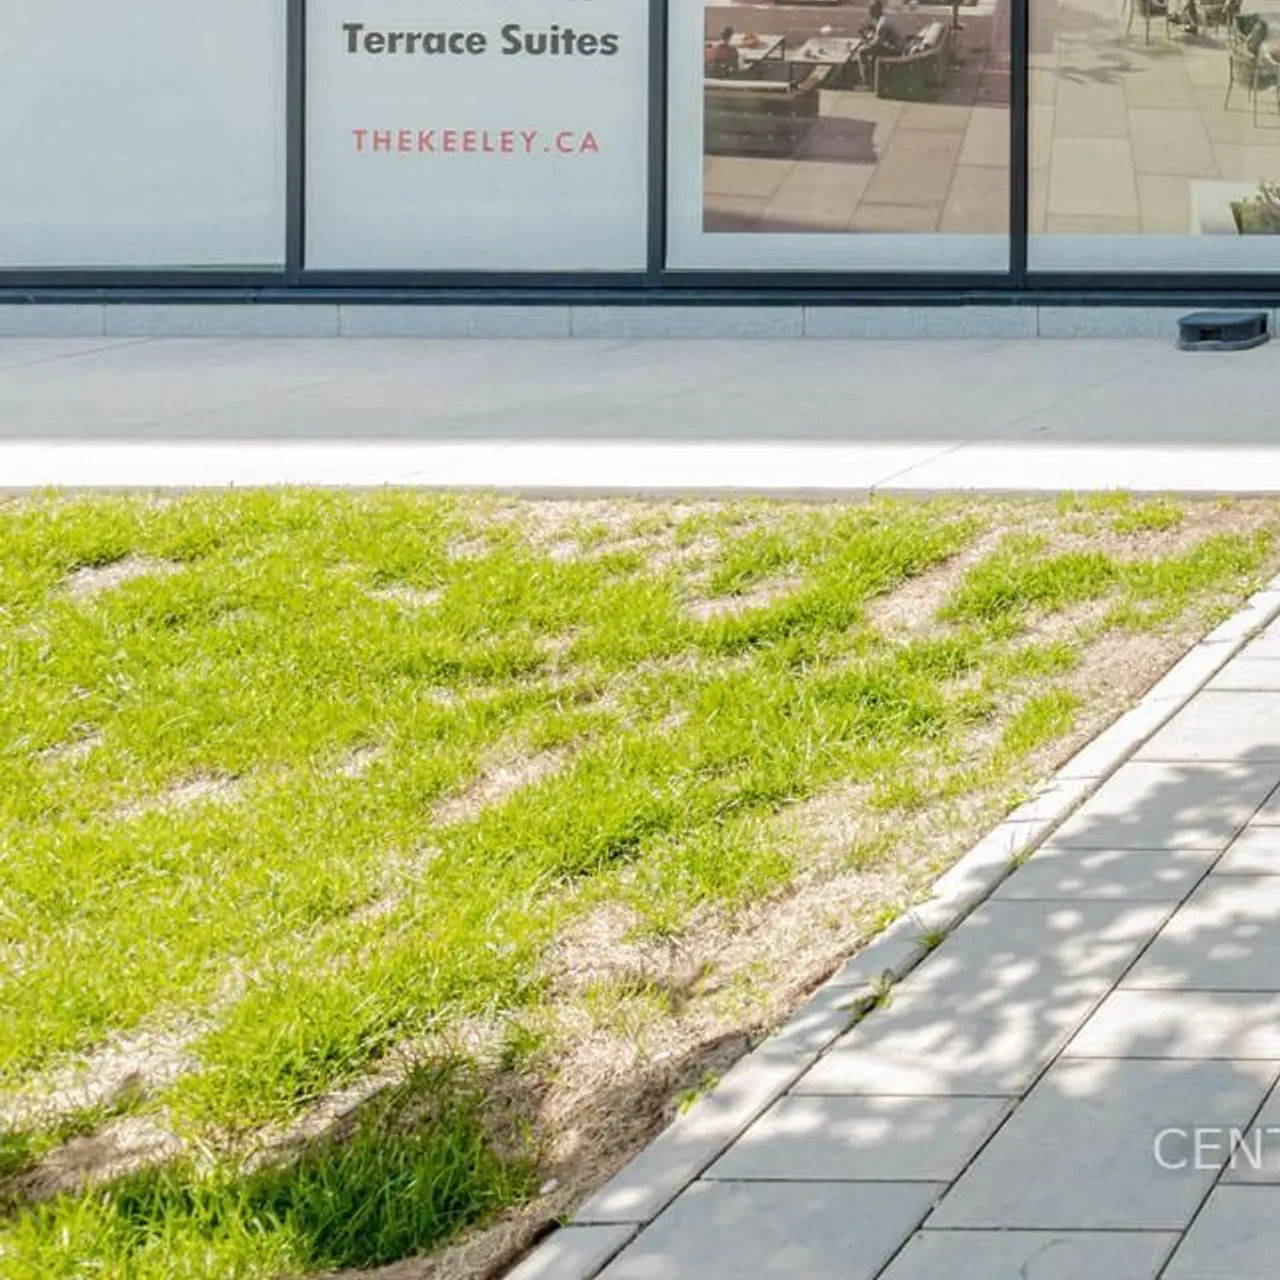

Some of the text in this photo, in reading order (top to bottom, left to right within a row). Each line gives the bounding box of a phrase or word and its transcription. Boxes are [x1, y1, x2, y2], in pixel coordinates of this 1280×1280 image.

[342, 23, 619, 56] Terrace Suites
[352, 130, 599, 153] THEKEELEY.CA
